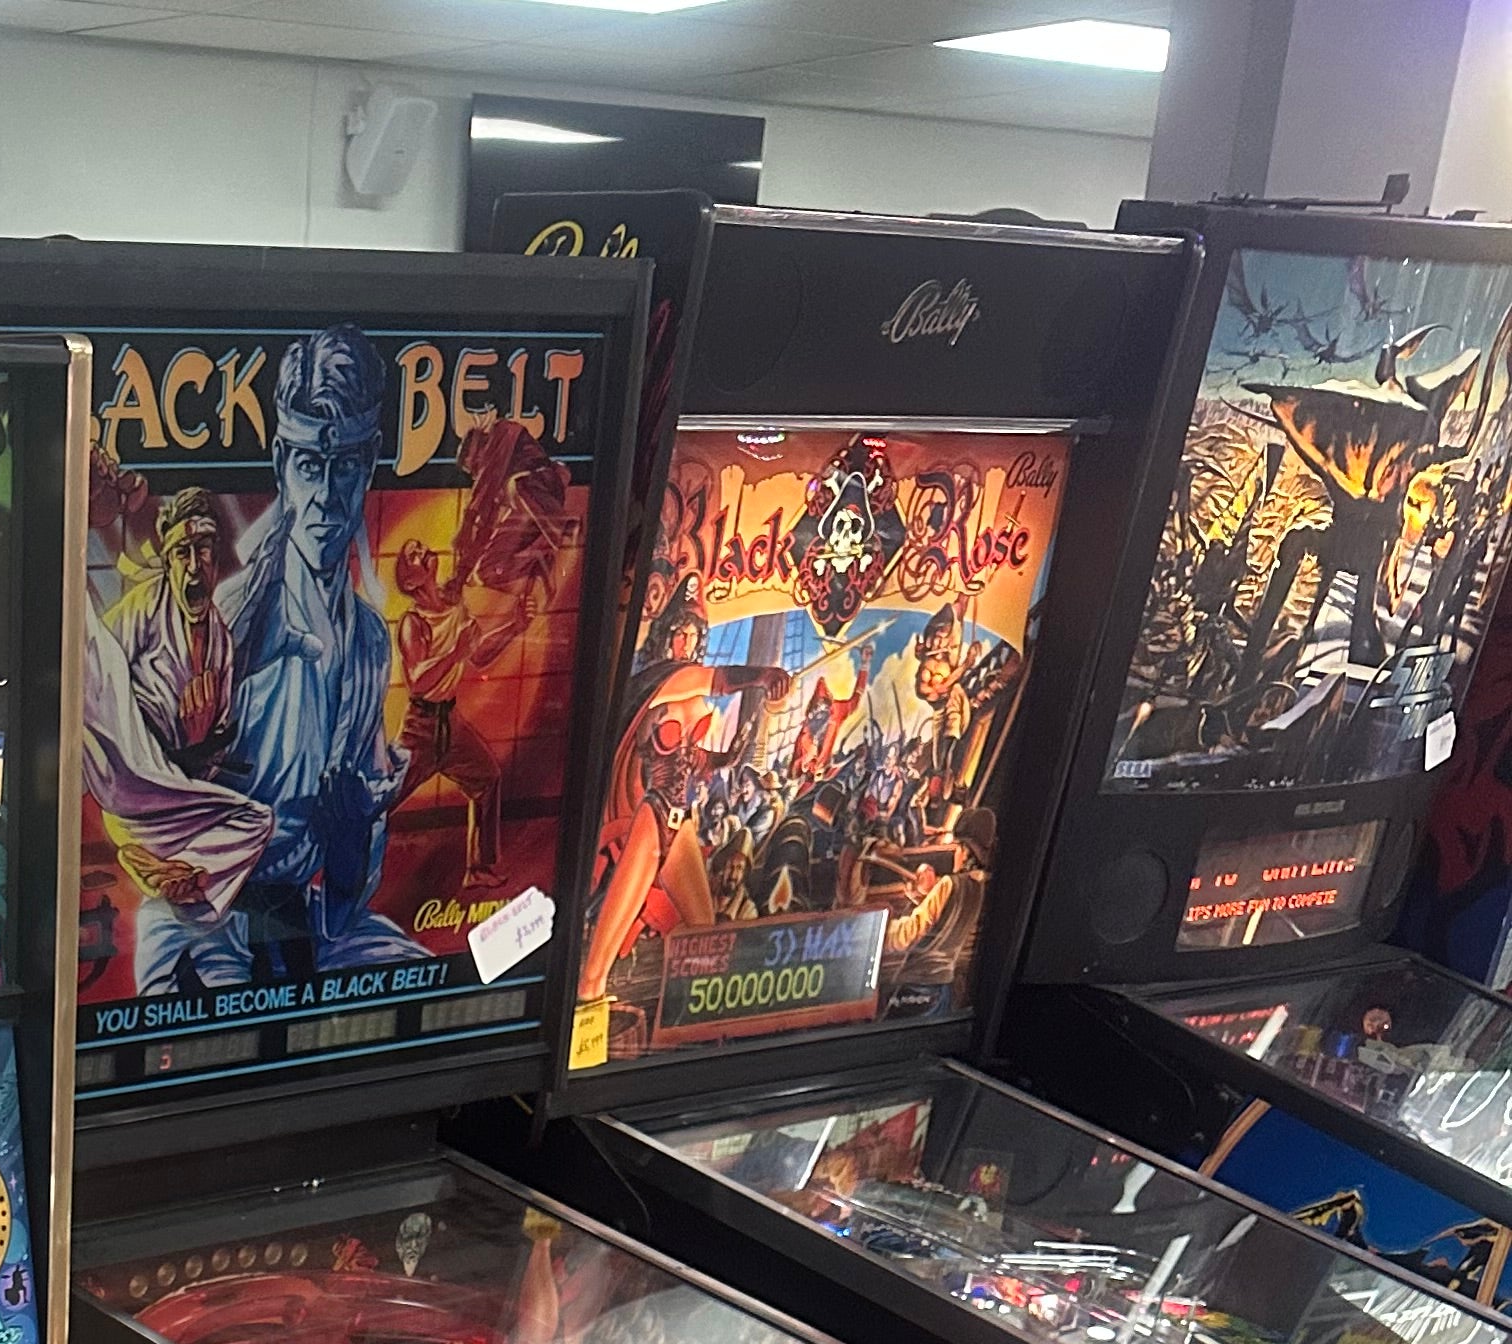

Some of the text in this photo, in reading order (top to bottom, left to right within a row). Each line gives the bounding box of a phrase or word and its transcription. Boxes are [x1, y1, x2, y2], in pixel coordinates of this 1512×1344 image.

[880, 278, 981, 346] Bally
[396, 341, 585, 477] BELT
[1006, 451, 1059, 498] Bally
[662, 470, 1030, 584] Black Rose
[413, 898, 467, 935] Bally
[1214, 900, 1247, 918] MORE
[1271, 896, 1287, 911] TO
[1287, 889, 1339, 910] COMPETE
[671, 931, 737, 958] HIGHEST
[96, 963, 449, 1034] YOU SHALL BECOME A BLACK BELT!
[688, 963, 824, 1016] 50,000,000
